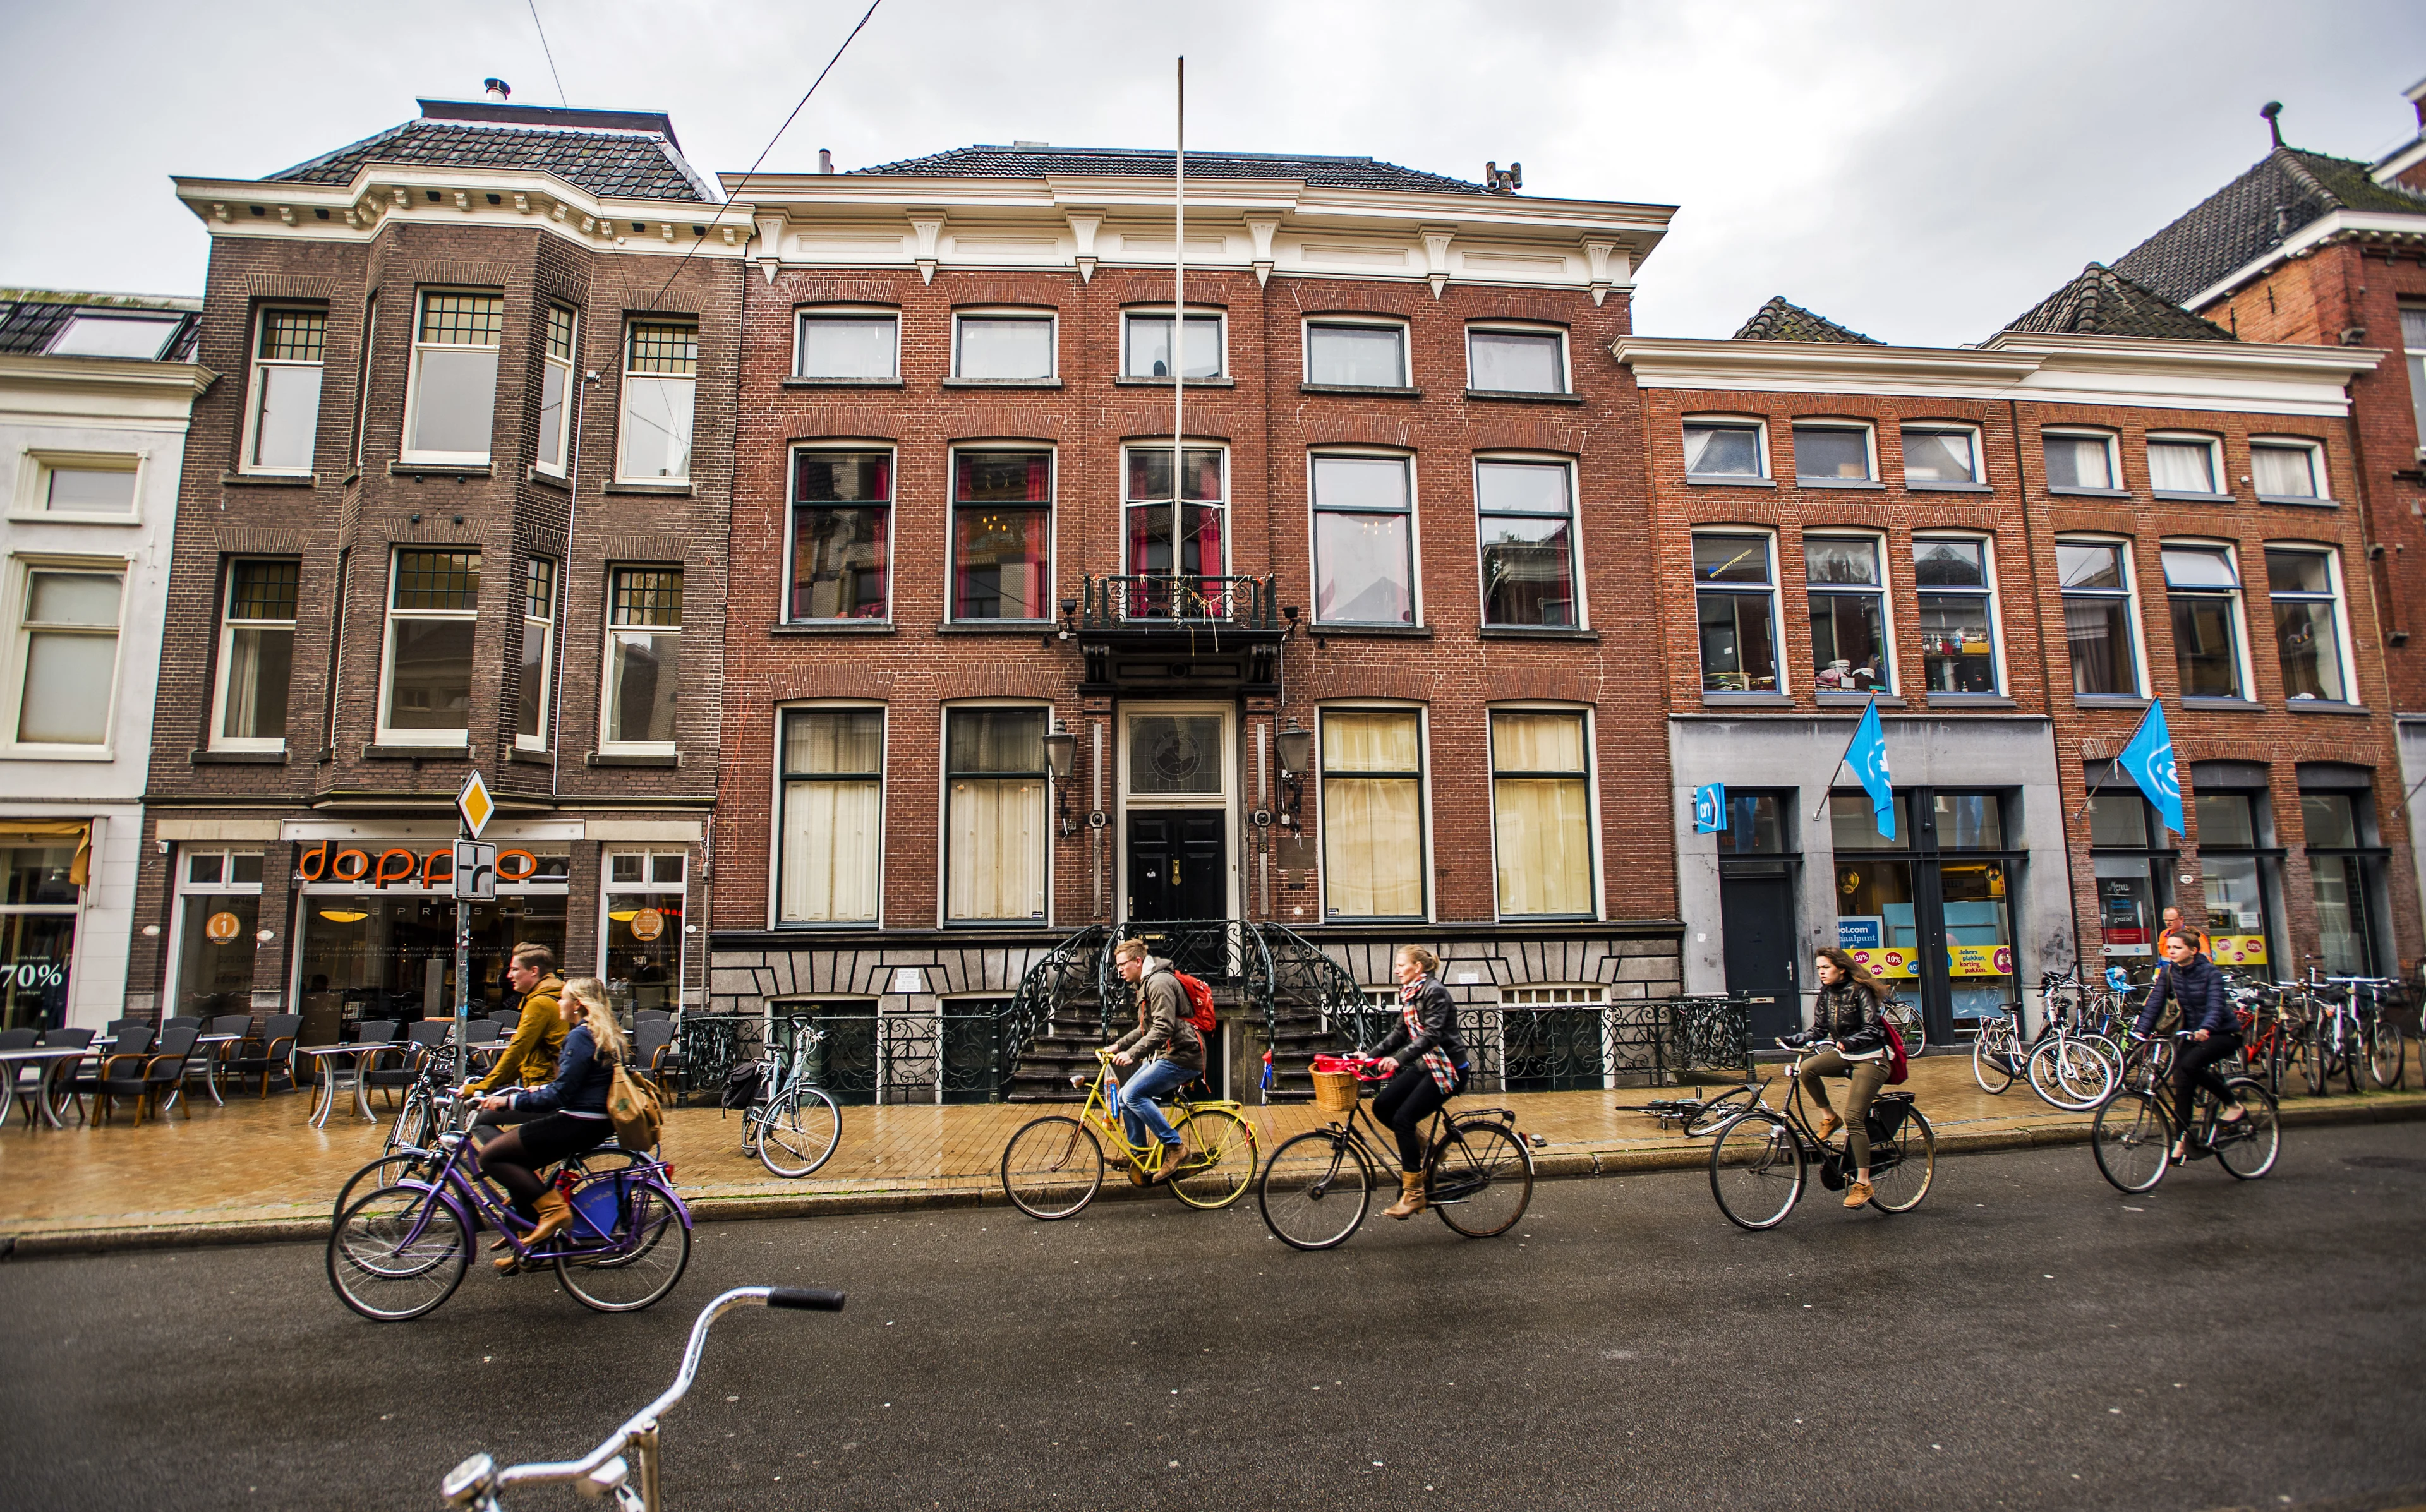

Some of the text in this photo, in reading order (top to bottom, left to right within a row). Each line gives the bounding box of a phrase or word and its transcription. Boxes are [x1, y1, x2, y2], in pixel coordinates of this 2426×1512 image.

[1259, 843, 1268, 853] 8
[300, 840, 538, 889] doppo
[2108, 881, 2131, 894] Menu
[347, 908, 533, 916] ESPRESSO
[220, 921, 227, 934] 1
[1854, 952, 1869, 961] 30%
[1886, 956, 1902, 964] 10%
[0, 964, 62, 988] 70%
